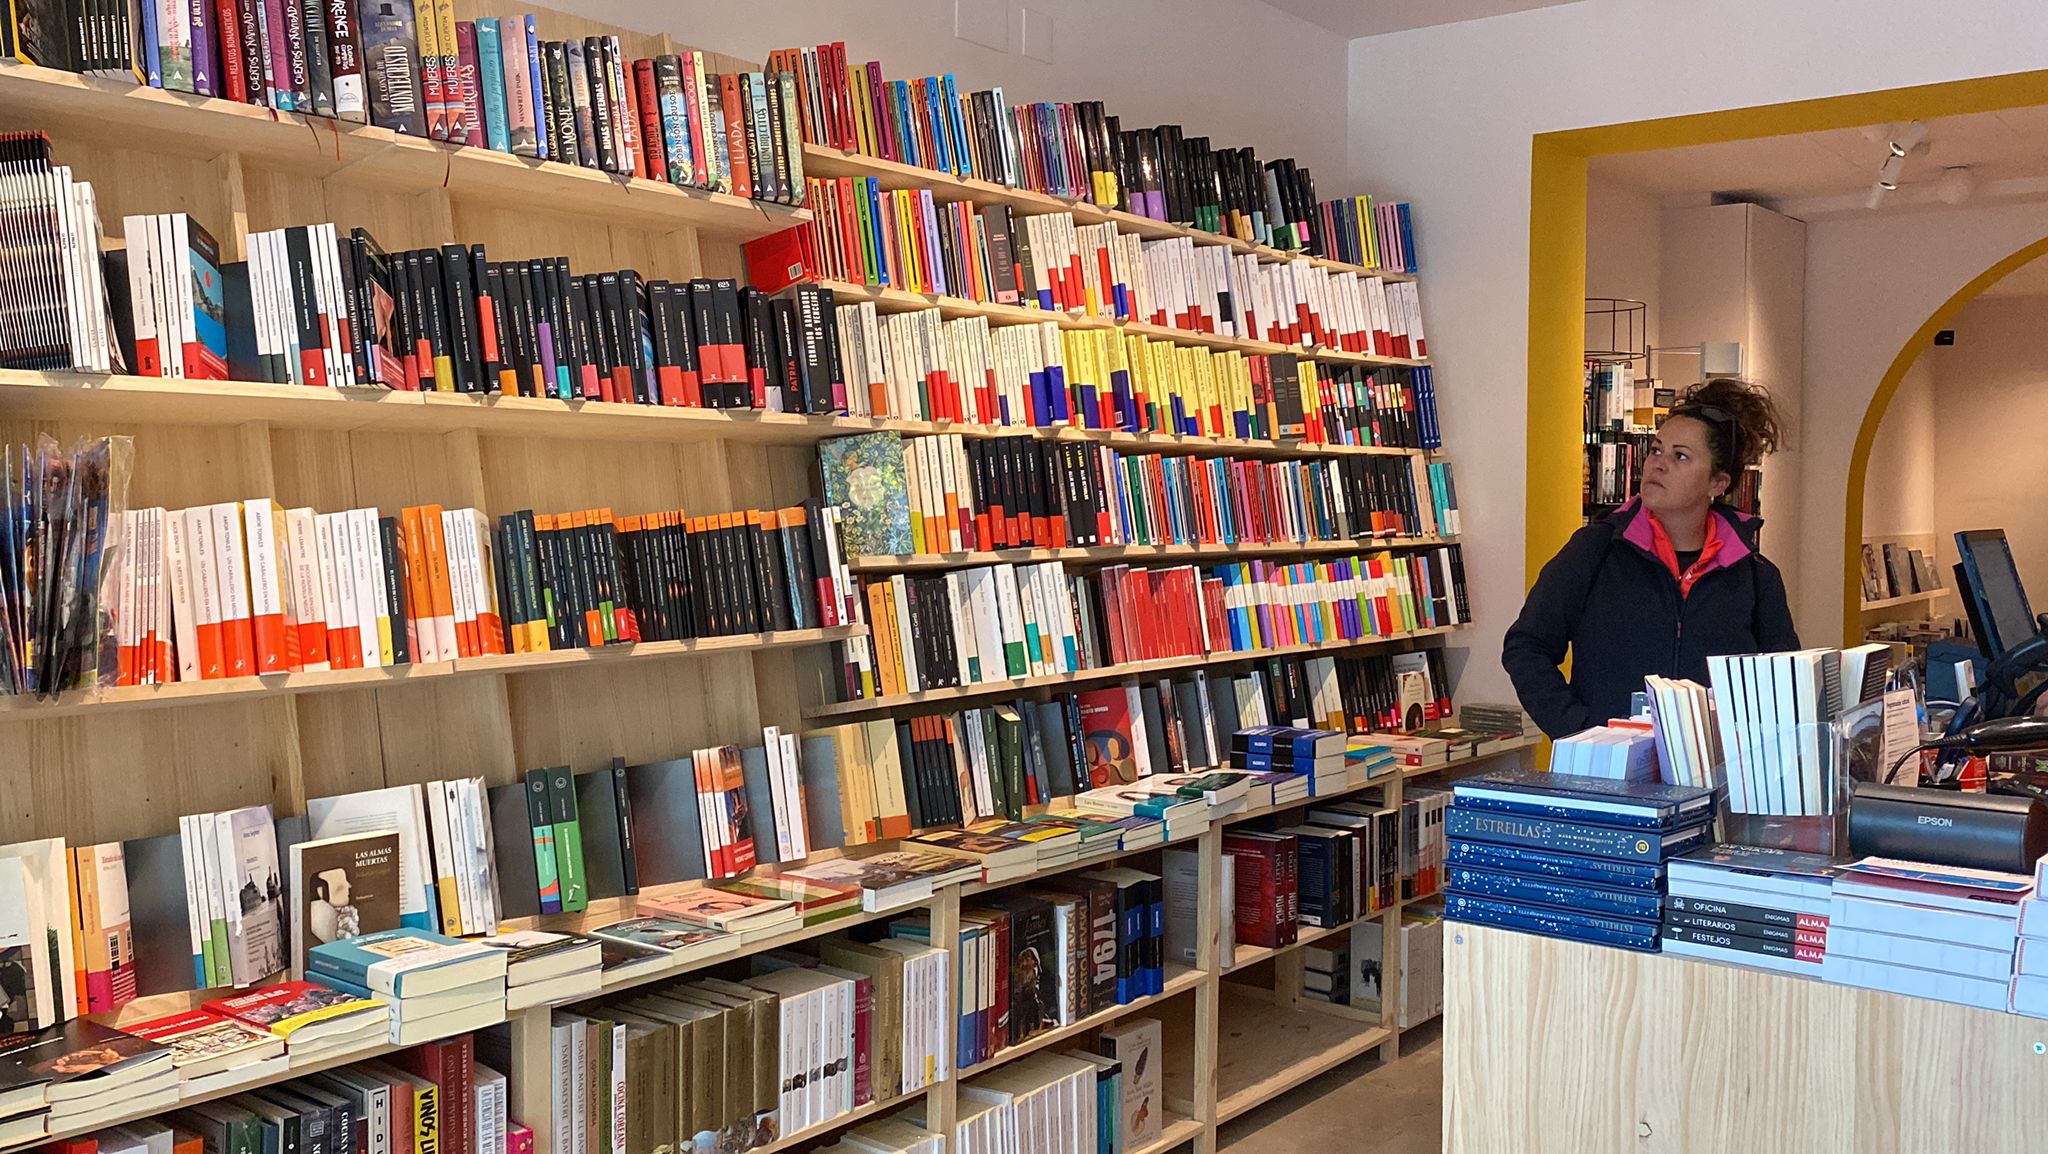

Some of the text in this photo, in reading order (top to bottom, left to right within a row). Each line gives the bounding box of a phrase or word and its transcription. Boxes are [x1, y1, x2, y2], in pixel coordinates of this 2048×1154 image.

[189, 0, 199, 16] ÚLTI
[286, 5, 300, 40] NAVIDAD
[303, 0, 324, 33] FANTASM
[242, 11, 256, 47] NAVIDAD
[260, 32, 270, 61] CUERVO
[227, 49, 237, 74] RELATOS
[247, 56, 262, 91] CUENTOS
[292, 49, 306, 84] CUENTOS
[424, 55, 441, 95] MUJERES
[443, 55, 461, 95] MUJERES
[376, 60, 389, 100] EL CONDE DE
[383, 44, 414, 113] MONTECRISTO
[684, 73, 698, 105] WOOLF
[457, 63, 481, 131] MUJERCITAS
[514, 72, 525, 122] MANSFIELD PARK
[594, 82, 607, 120] LEYENDAS
[620, 99, 628, 125] CUERVO
[548, 133, 556, 149] GRAN
[558, 105, 576, 154] EL MONJE
[601, 125, 611, 150] RIMAS
[667, 90, 684, 164] ROBINSON CRUSOE
[729, 119, 744, 164] ILIADA
[753, 107, 773, 167] HOMBRECITOS
[750, 158, 758, 173] GRAN
[346, 289, 355, 310] MÁGICA
[349, 311, 359, 344] JUGUETERÍA
[799, 290, 818, 367] FERNANDO ARAMBURU
[809, 290, 823, 339] LOS VENCEJOS
[784, 334, 792, 356] FERNANDO
[787, 360, 798, 391] PATRIA
[200, 568, 209, 598] CABALLERO
[226, 564, 235, 593] CABALLERO
[259, 561, 268, 590] CABALLERO
[230, 594, 235, 602] EN
[204, 605, 212, 623] MOSC
[1475, 817, 1541, 839] ESTRELLAS
[1917, 815, 1953, 828] EPSON
[355, 847, 392, 860] LAS ALMAS
[355, 856, 388, 868] MUERTAS
[1592, 863, 1636, 875] ESTRELLAS
[1274, 894, 1284, 924] NUNCA
[1287, 892, 1296, 921] NUNCA
[1593, 890, 1637, 904] ESTRELLAS
[1693, 902, 1727, 914] OFICINA
[1589, 919, 1633, 933] ESTRELLAS
[1692, 918, 1736, 931] LITERARIOS
[1764, 913, 1790, 923] ENIGMAS
[1798, 917, 1827, 929] ALMA
[1090, 907, 1117, 984] 1794
[1692, 933, 1731, 945] FESTEJOS
[1763, 929, 1789, 938] ENIGMAS
[1797, 933, 1825, 945] ALMA
[1763, 944, 1788, 954] ENIGMAS
[1797, 949, 1824, 960] ALMA
[560, 1044, 568, 1076] ISABEL
[576, 1039, 584, 1071] ISABEL
[560, 1078, 569, 1120] MAESTRE
[576, 1073, 584, 1113] MAESTRE
[419, 1088, 435, 1136] VINOS
[577, 1119, 584, 1129] EL
[616, 1081, 625, 1149] COCINA COREANA
[340, 1111, 348, 1150] COCINA
[561, 1125, 568, 1134] EL
